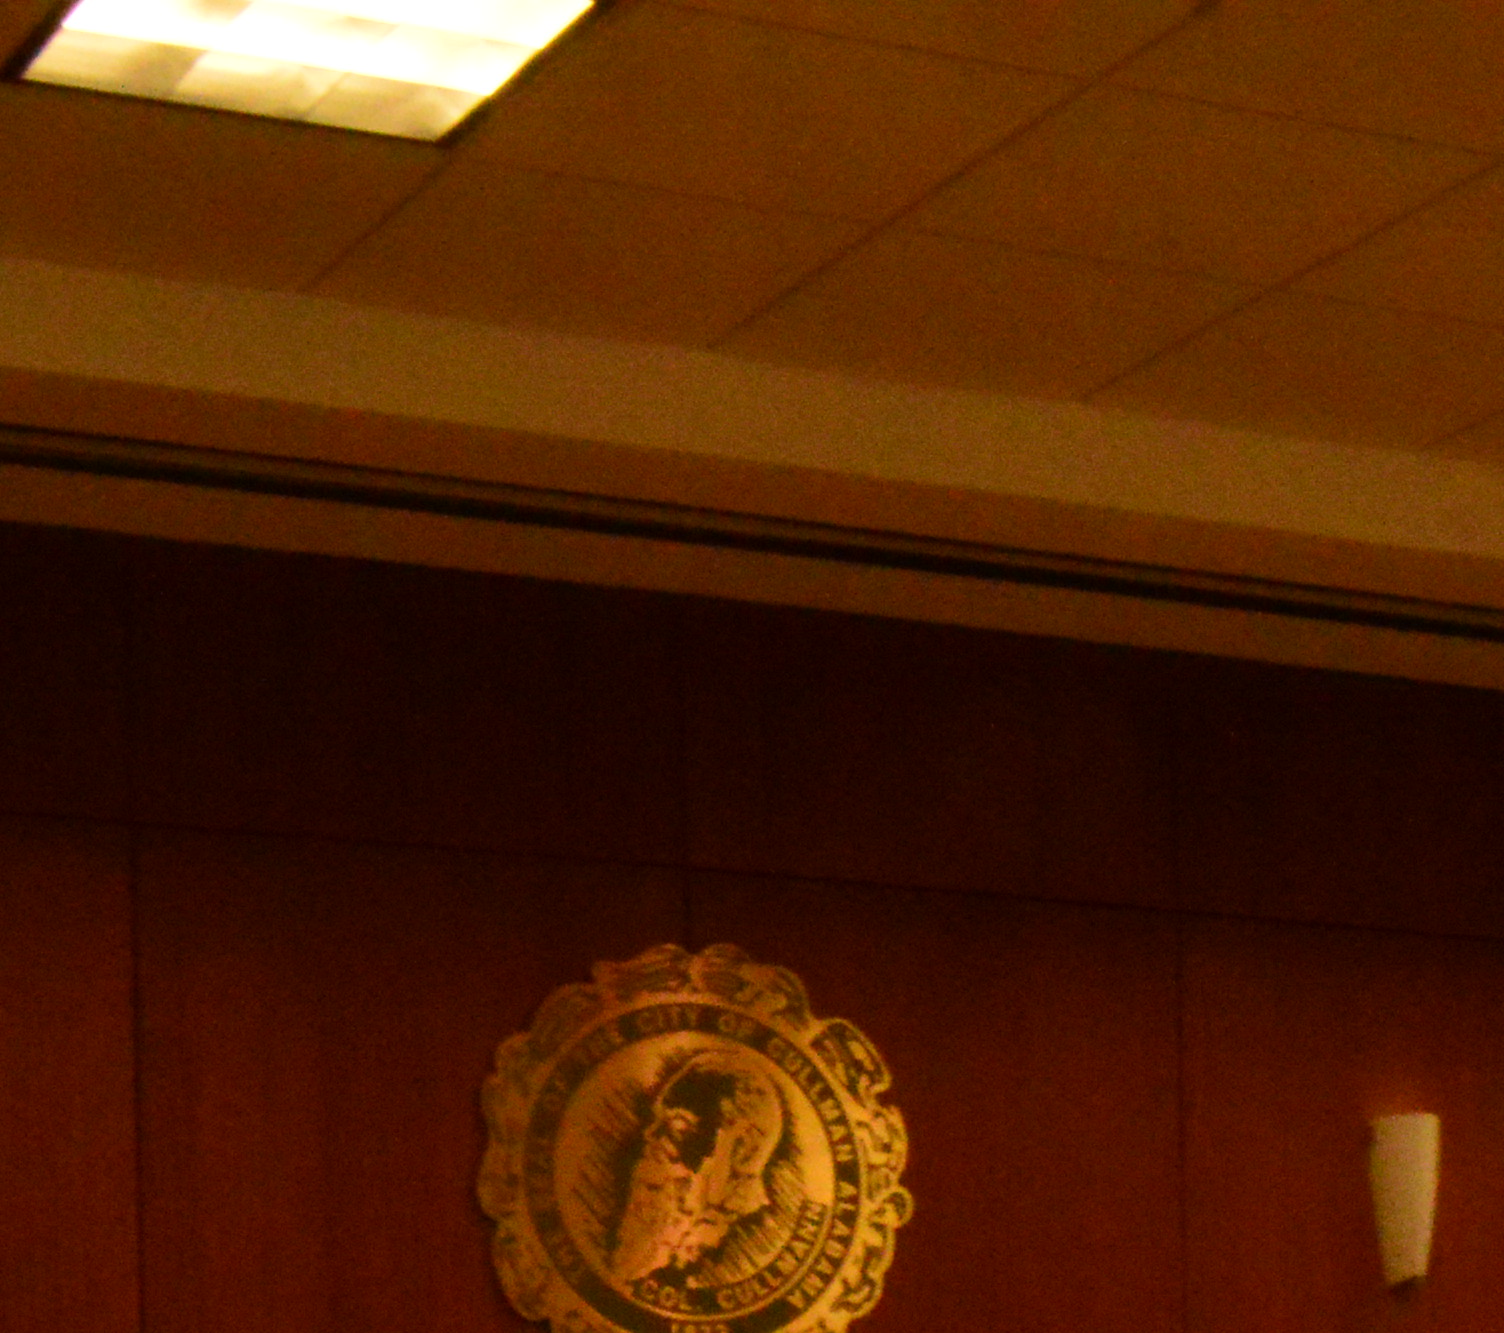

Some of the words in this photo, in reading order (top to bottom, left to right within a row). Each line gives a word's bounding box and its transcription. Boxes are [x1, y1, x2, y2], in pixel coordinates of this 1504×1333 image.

[635, 1005, 699, 1035] CITY
[718, 1010, 757, 1038] OF
[765, 1036, 854, 1163] CULLMAN
[717, 1201, 824, 1310] CULLMANN
[784, 1181, 860, 1310] ALABAMA
